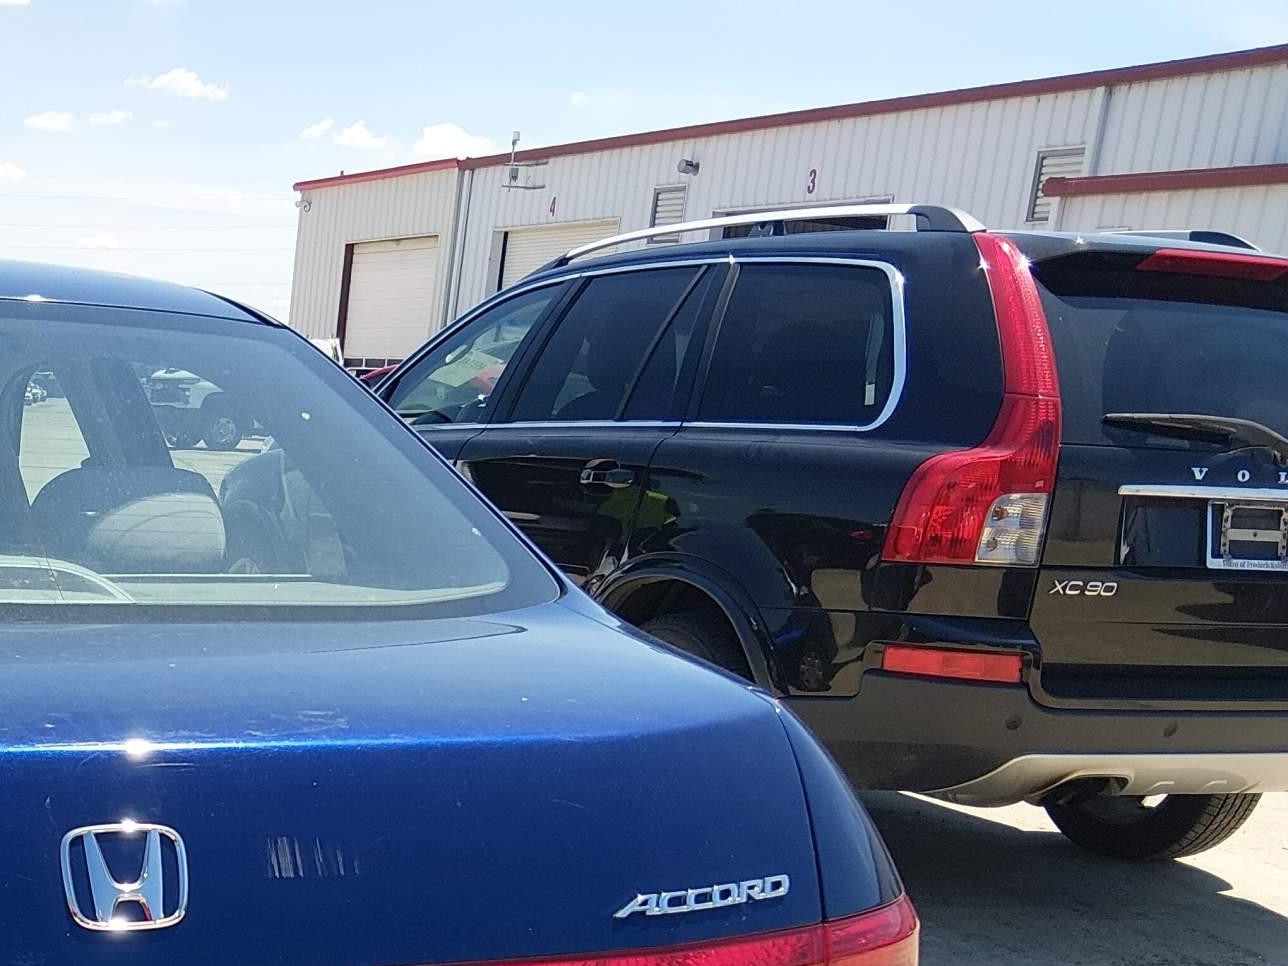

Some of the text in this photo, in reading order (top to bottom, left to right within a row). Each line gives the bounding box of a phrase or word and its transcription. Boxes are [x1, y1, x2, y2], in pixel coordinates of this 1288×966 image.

[807, 168, 817, 194] 3
[549, 196, 557, 217] 4
[613, 874, 790, 917] ACCORD
